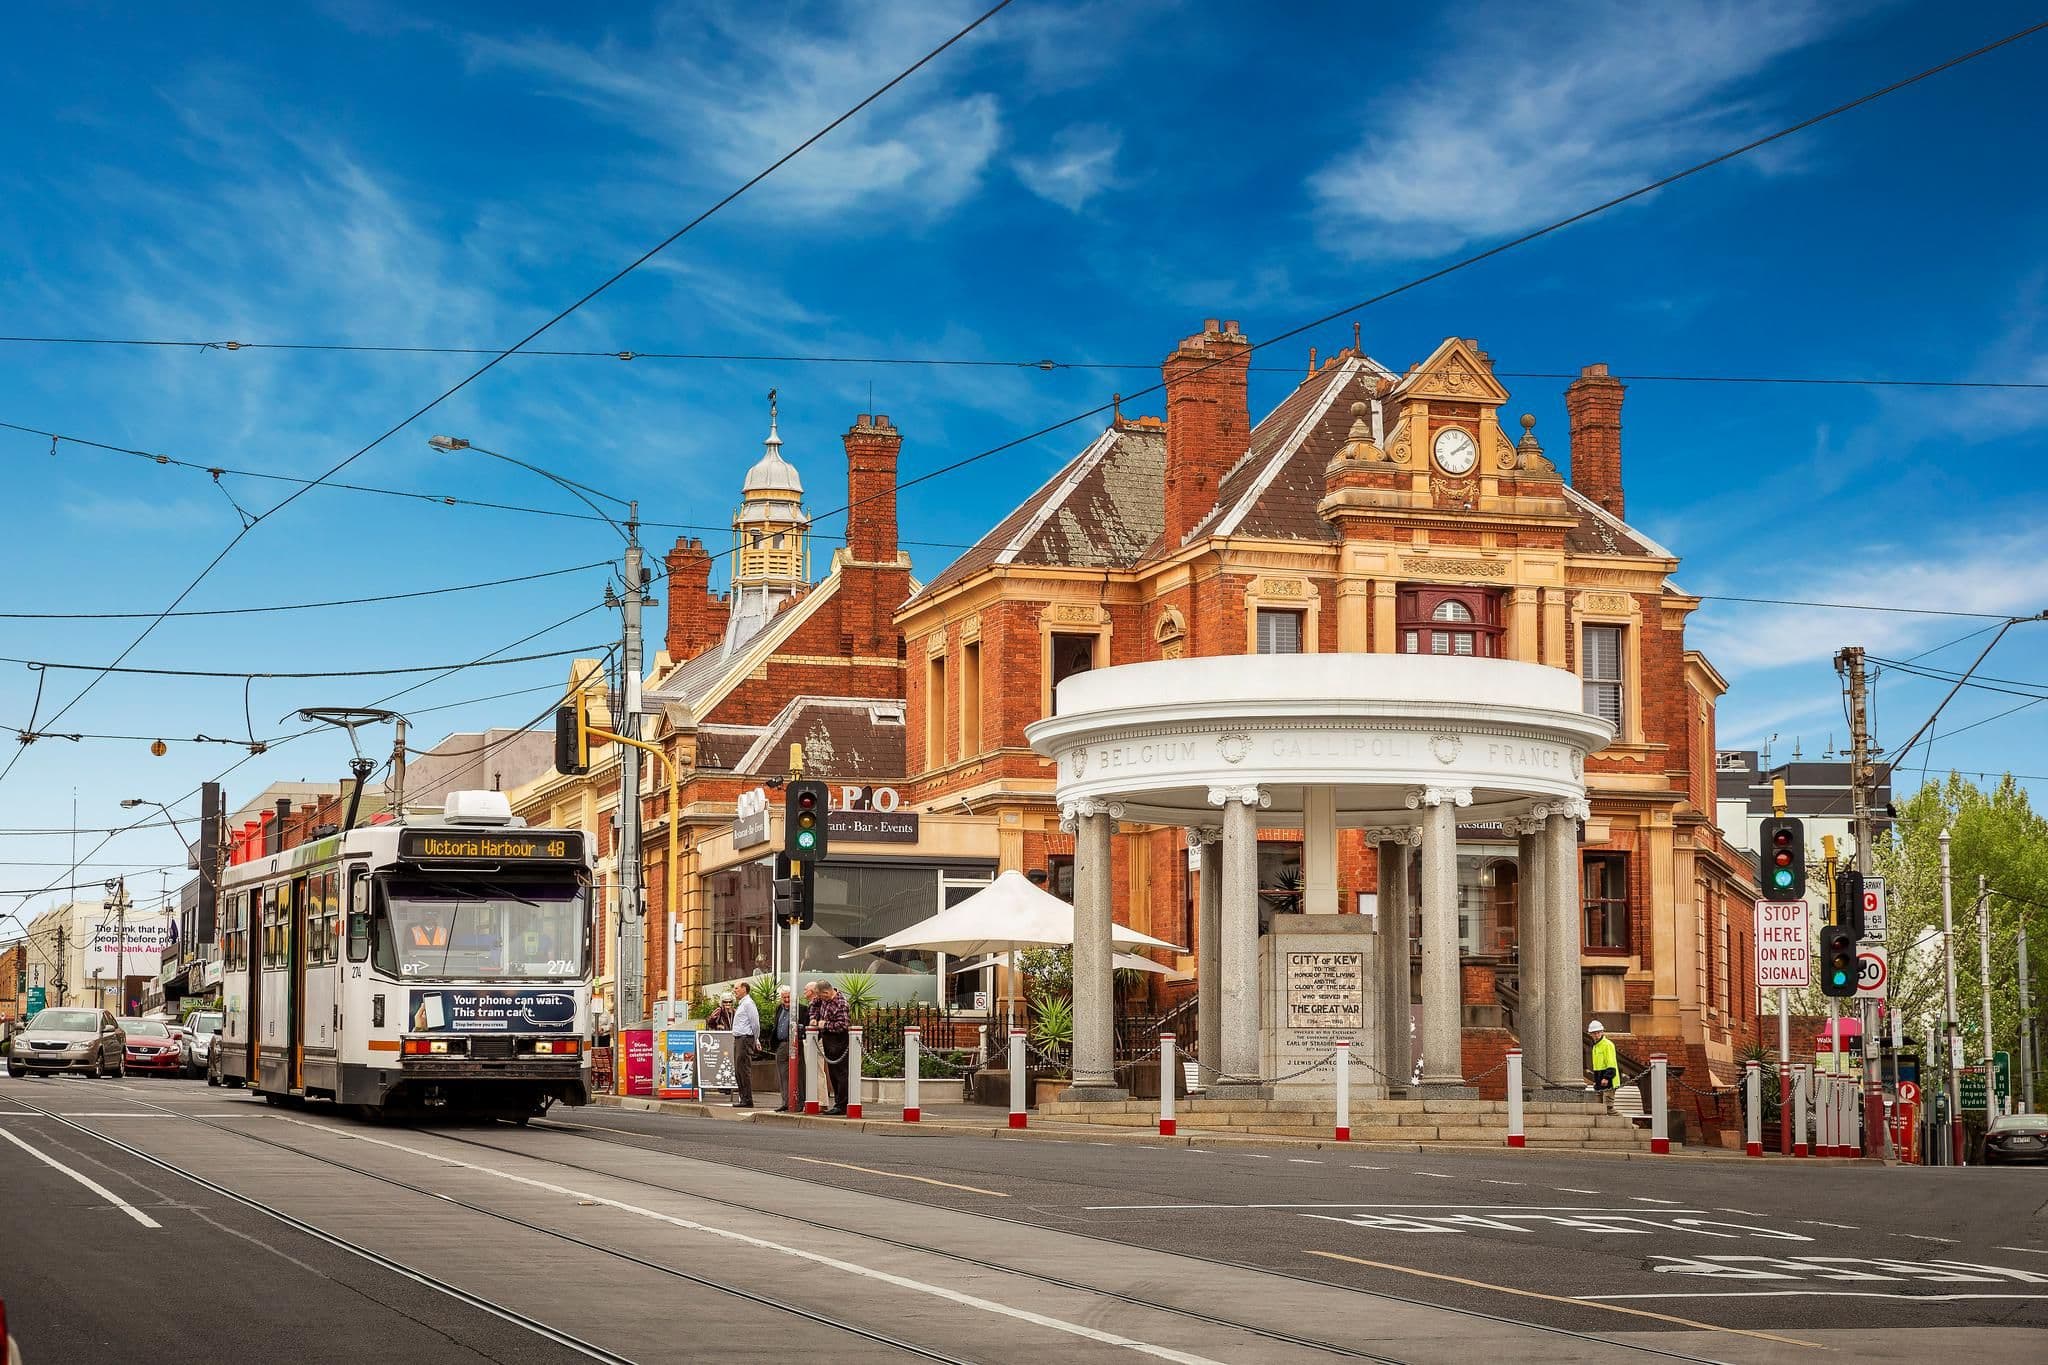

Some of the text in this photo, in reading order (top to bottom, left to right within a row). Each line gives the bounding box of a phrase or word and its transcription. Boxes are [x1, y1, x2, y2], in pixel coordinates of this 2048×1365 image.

[1100, 742, 1196, 768] BELGIUM
[1488, 744, 1560, 768] FRANCE
[854, 821, 873, 832] Bar
[880, 821, 913, 833] Events
[424, 838, 565, 857] Victoria Harbour 48
[1764, 906, 1801, 921] STOP
[95, 925, 111, 933] The
[138, 925, 155, 933] that
[1764, 927, 1802, 942] HERE
[128, 935, 156, 943] before
[94, 944, 102, 952] is
[1761, 948, 1805, 961] ON RED
[1292, 955, 1320, 965] CITY
[1334, 955, 1358, 965] KEW
[351, 966, 362, 979] 274
[547, 960, 575, 975] 274
[1761, 967, 1806, 980] SIGNAL
[453, 995, 563, 1007] Your phone can wait.
[453, 1007, 476, 1017] This
[477, 1008, 505, 1017] tram
[1291, 1004, 1360, 1014] THE GREAT WAR
